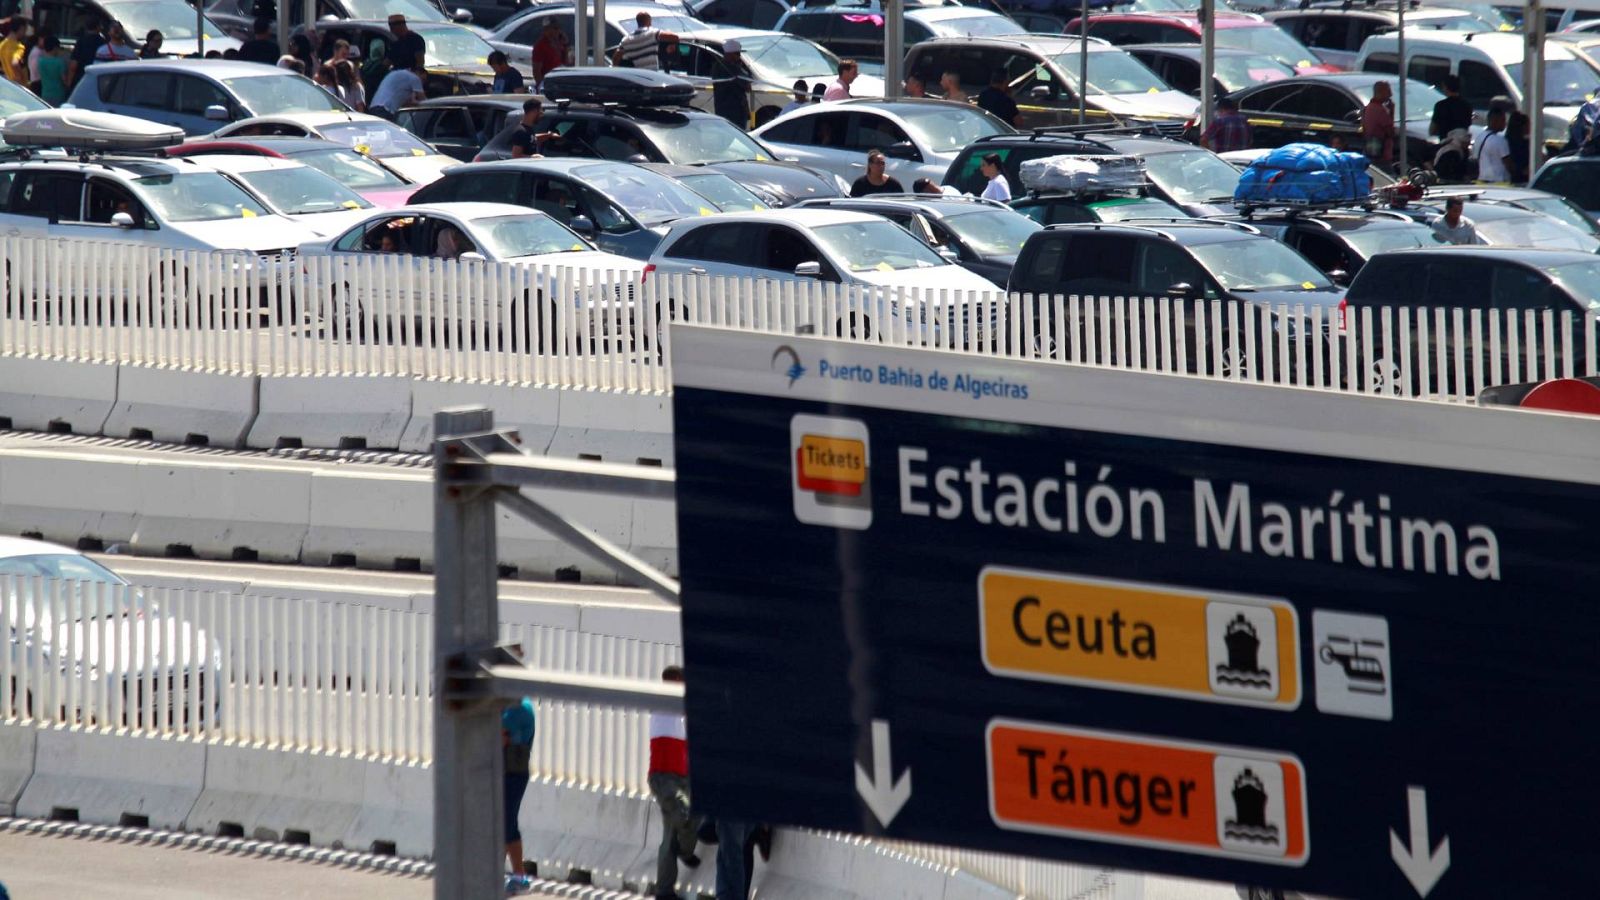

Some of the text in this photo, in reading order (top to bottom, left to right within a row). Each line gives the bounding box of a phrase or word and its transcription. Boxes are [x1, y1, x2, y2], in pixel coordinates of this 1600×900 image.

[819, 359, 873, 383] Puerto
[928, 370, 949, 390] de
[953, 374, 1029, 400] Algeciras
[806, 445, 861, 470] Tickets
[898, 446, 1501, 581] Estación Marítima
[1012, 595, 1157, 661] Ceuta
[1016, 745, 1196, 825] Tánger
